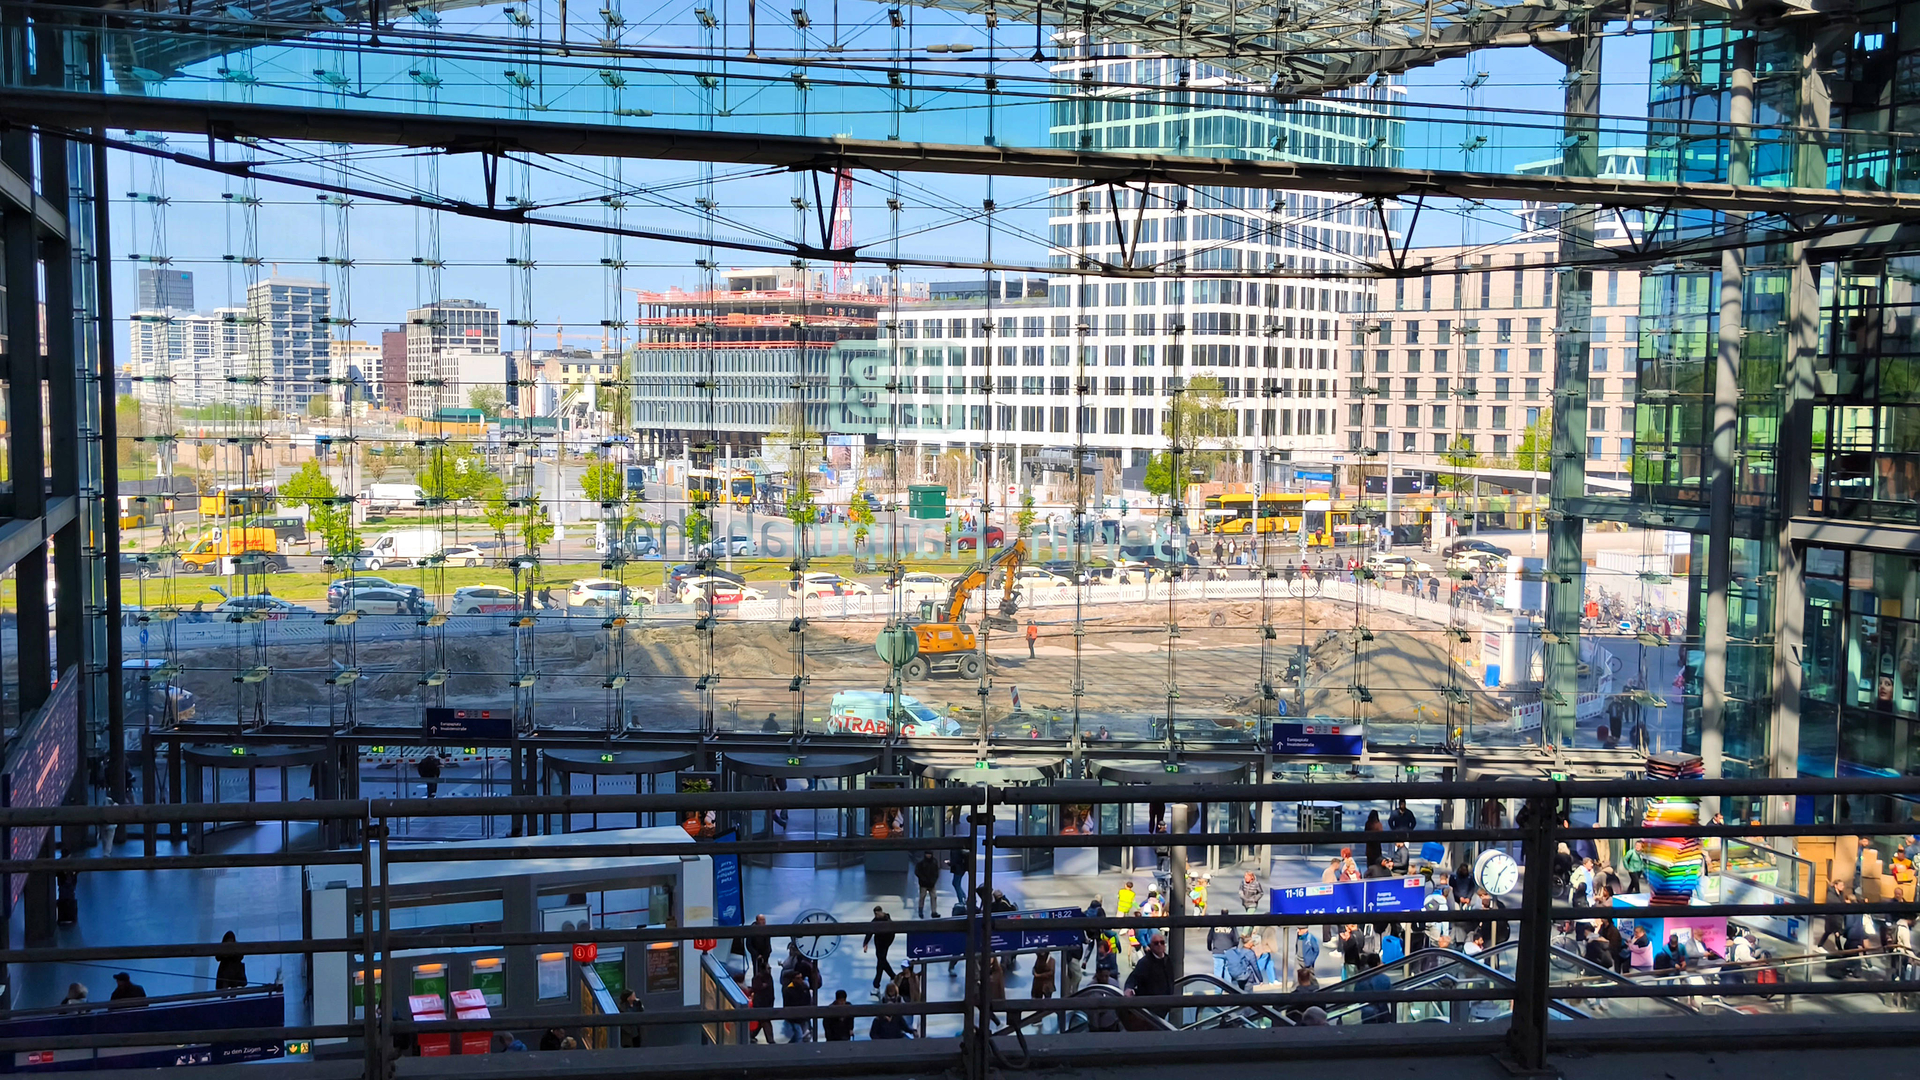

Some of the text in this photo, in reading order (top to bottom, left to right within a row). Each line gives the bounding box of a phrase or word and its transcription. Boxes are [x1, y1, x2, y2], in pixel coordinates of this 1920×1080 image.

[231, 539, 263, 547] DHL
[833, 714, 916, 736] STRABG
[1285, 888, 1304, 898] 11-16
